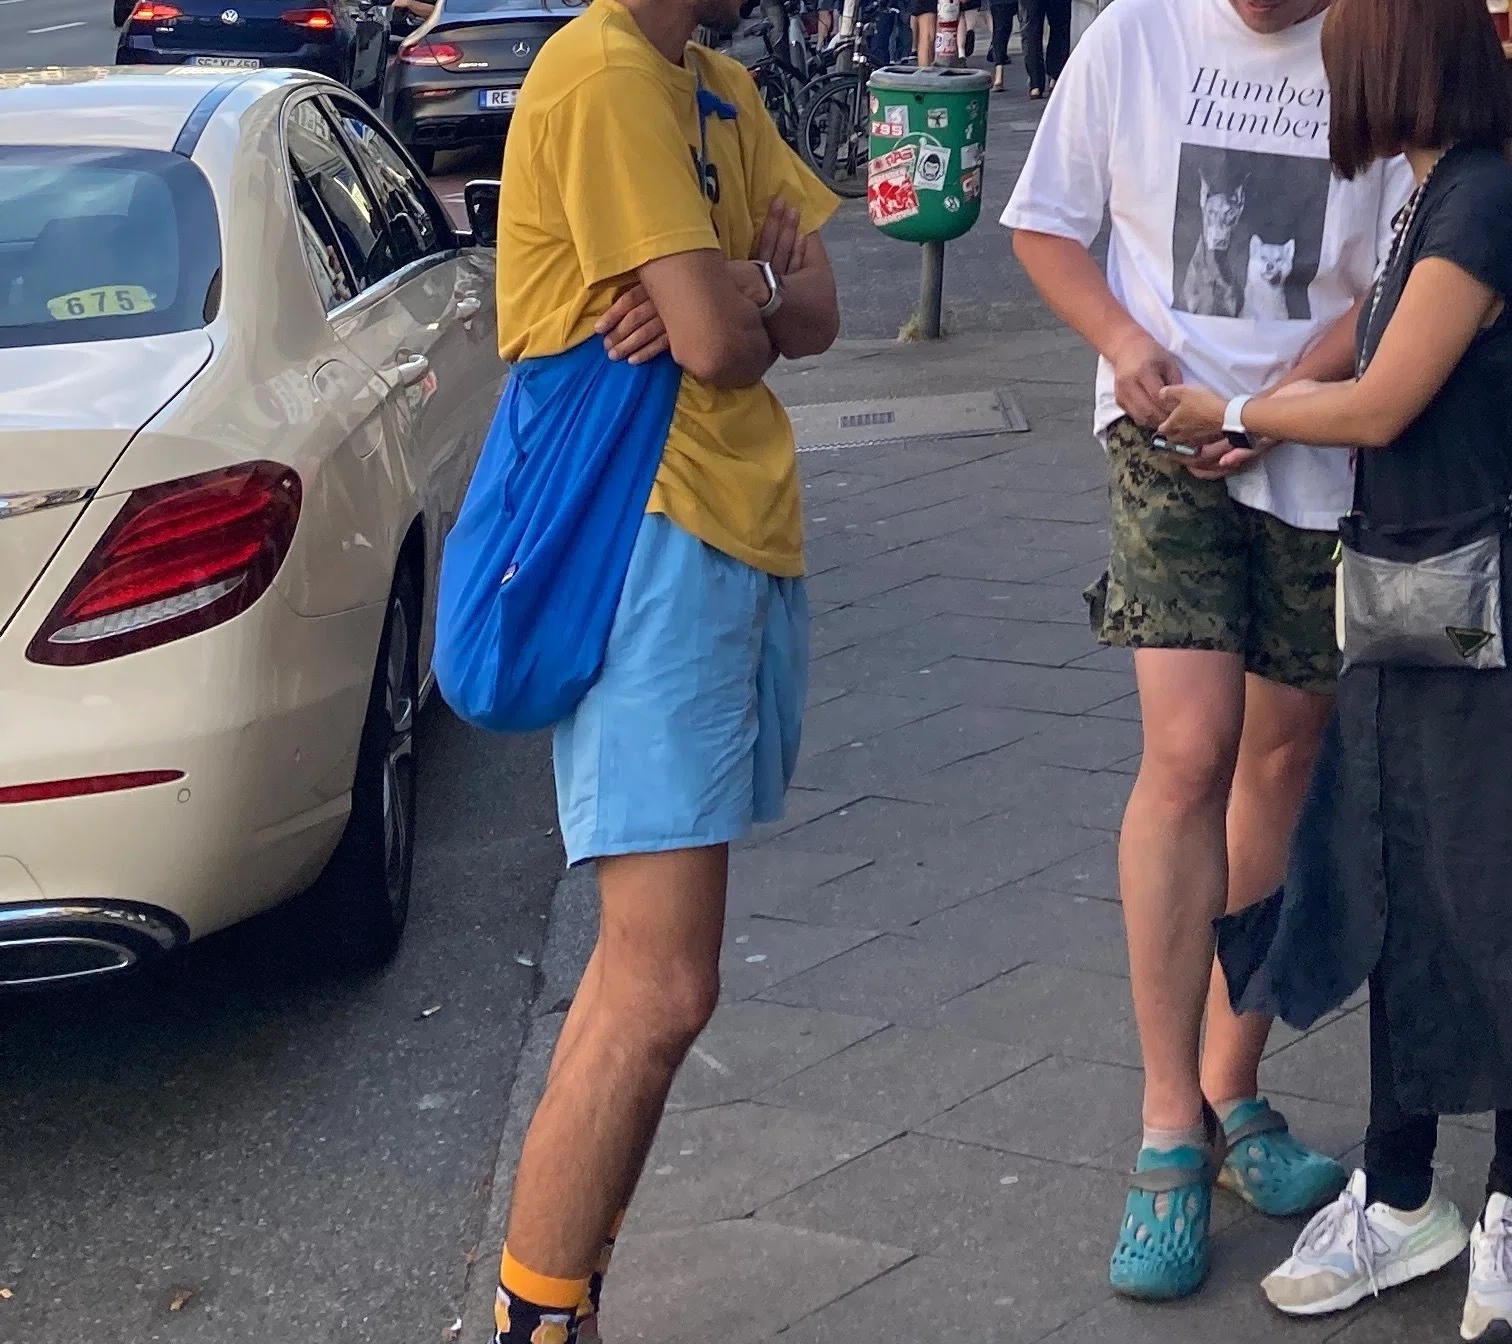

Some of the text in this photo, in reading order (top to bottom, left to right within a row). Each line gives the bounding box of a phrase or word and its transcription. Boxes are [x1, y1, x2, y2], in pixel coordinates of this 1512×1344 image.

[491, 91, 510, 105] RE
[1187, 66, 1331, 109] Humber
[1185, 98, 1331, 141] Humber
[65, 289, 136, 318] 675
